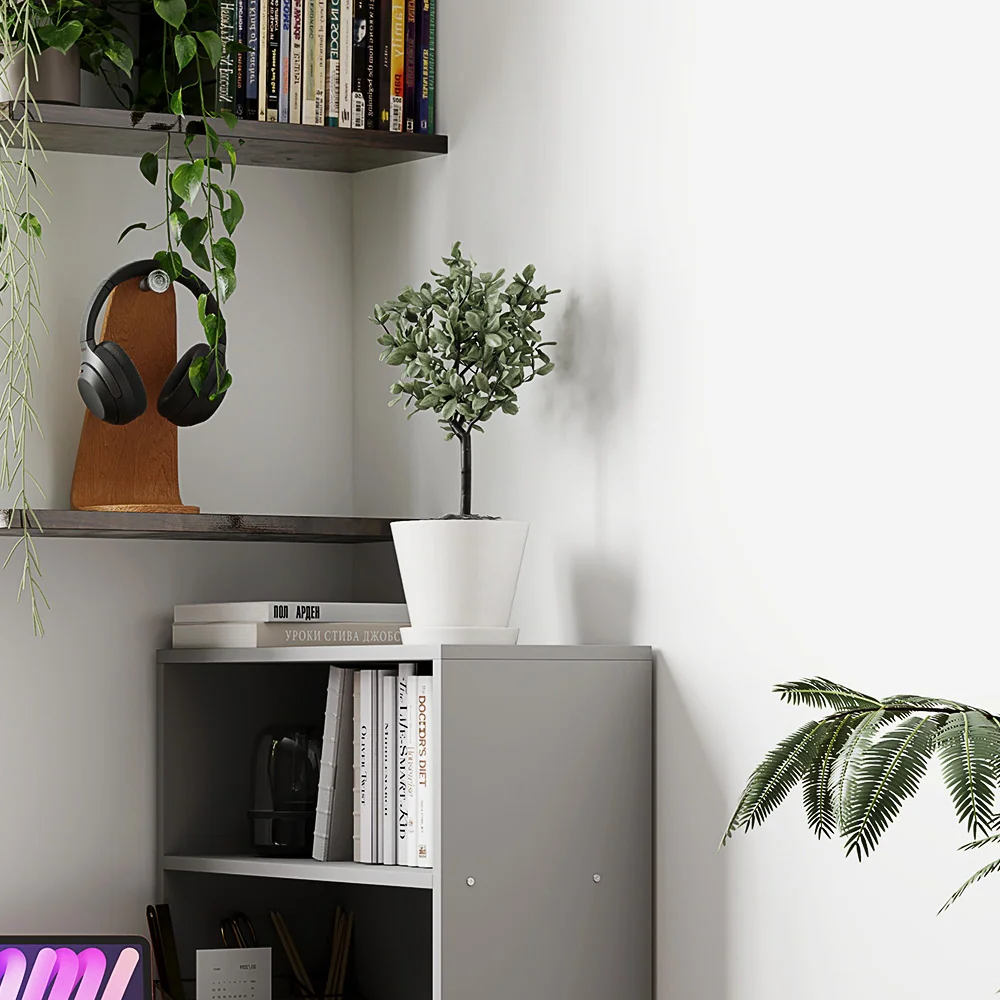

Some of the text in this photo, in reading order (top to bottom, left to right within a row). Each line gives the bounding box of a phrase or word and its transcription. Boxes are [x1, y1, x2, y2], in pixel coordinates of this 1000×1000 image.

[273, 605, 320, 621] ПОЛ АРДЕН
[285, 630, 401, 643] УРОКИ СТИВА ДЖОБС
[418, 760, 427, 787] DIET
